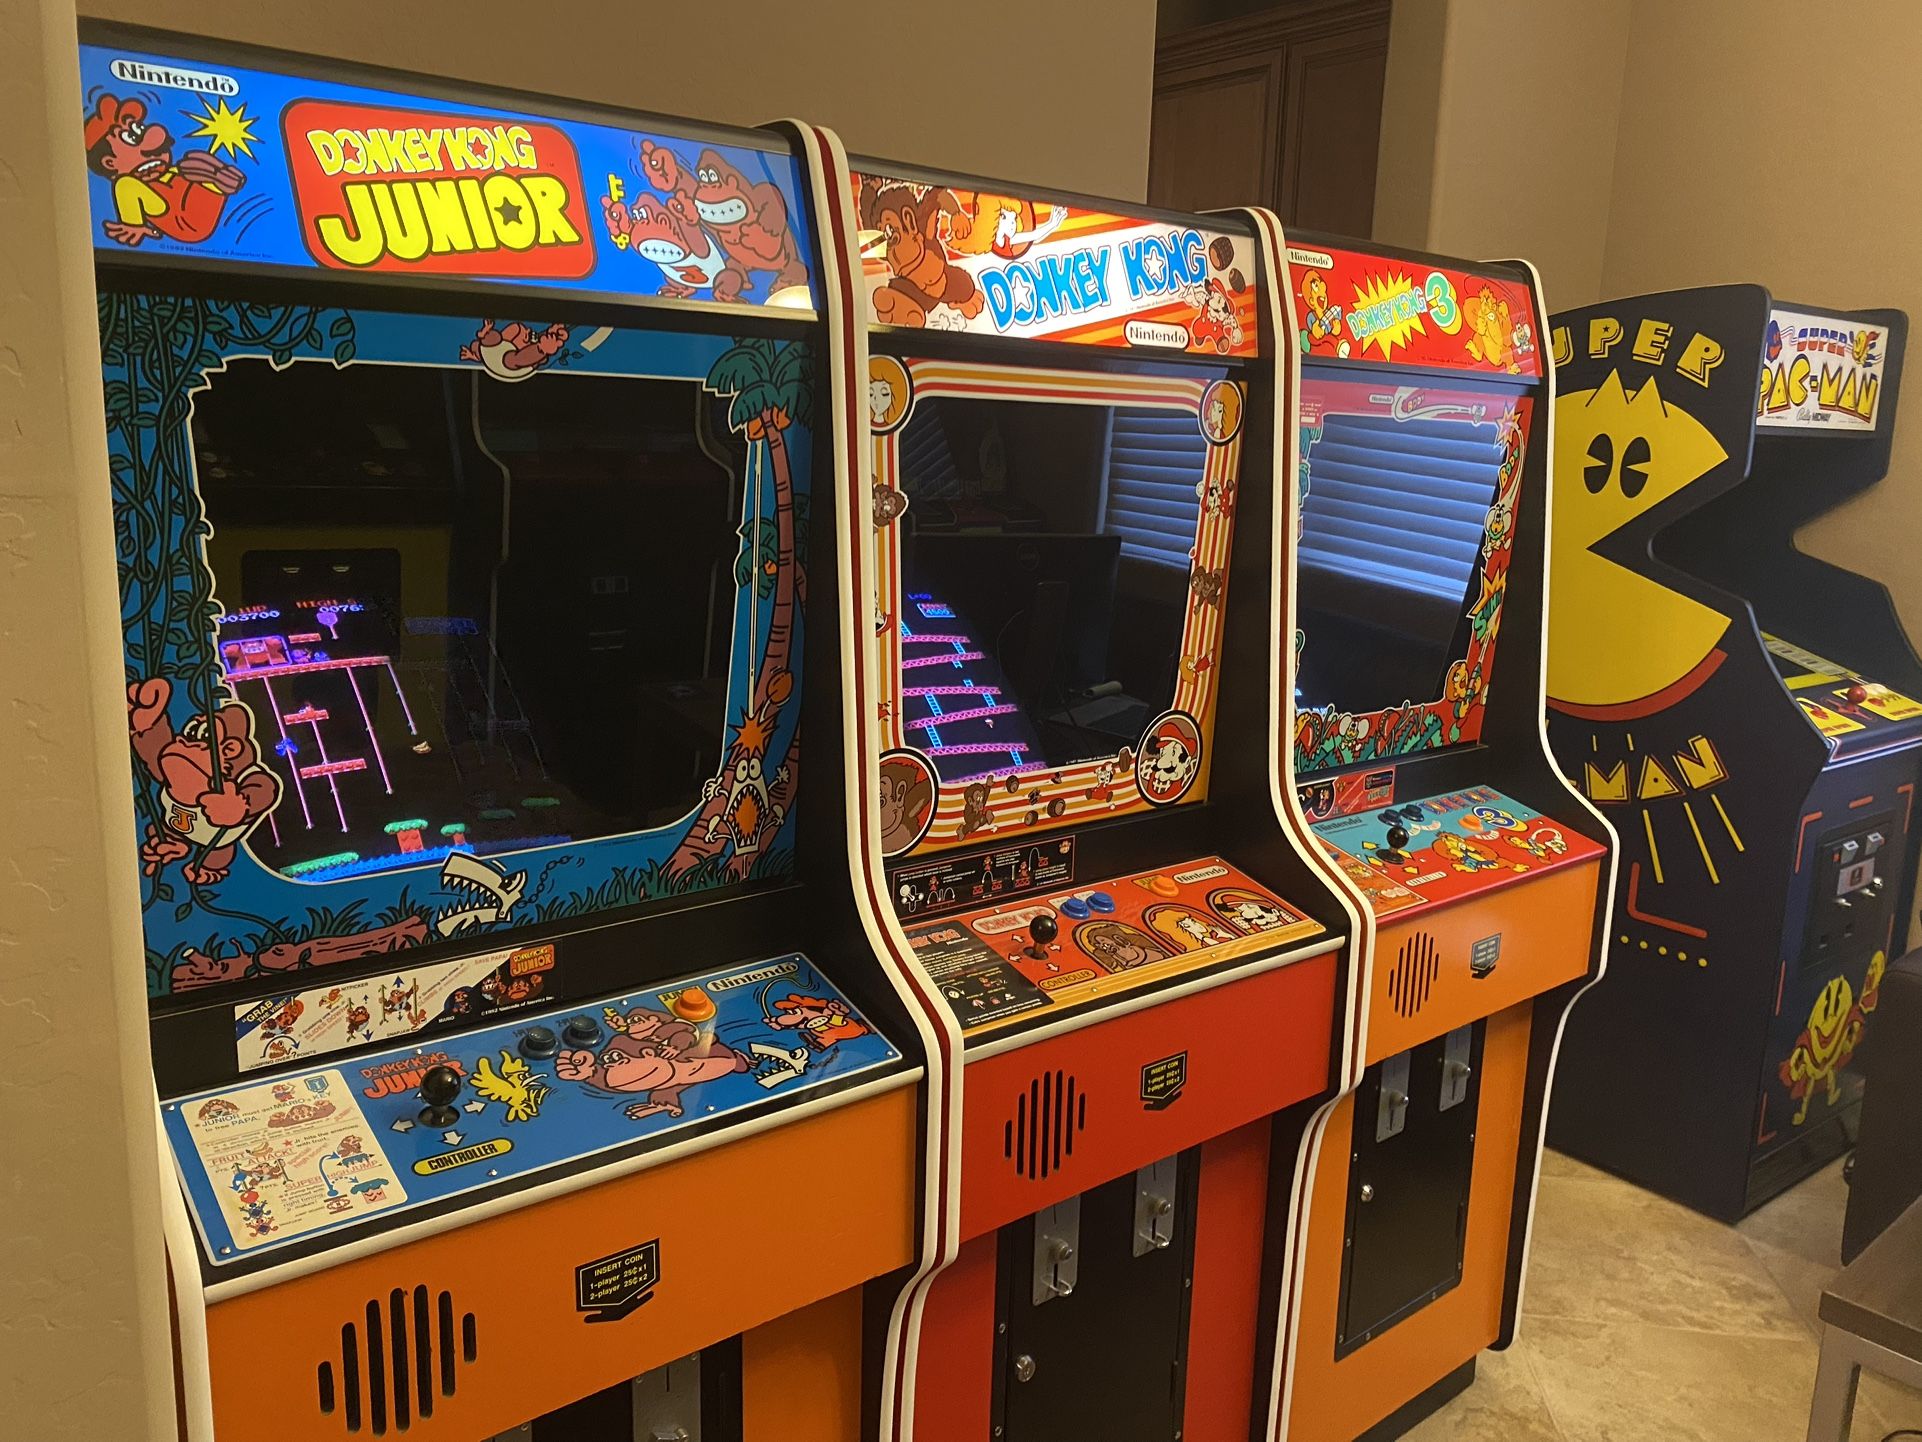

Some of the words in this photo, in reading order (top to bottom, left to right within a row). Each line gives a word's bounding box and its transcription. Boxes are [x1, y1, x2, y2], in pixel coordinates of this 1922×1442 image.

[117, 62, 234, 94] Nintendo
[307, 127, 444, 176] DONKEY
[443, 125, 538, 171] KONG
[315, 174, 583, 266] JUNIOR
[1290, 250, 1329, 266] Nintendo
[978, 245, 1111, 333] DONKEY
[1119, 228, 1209, 301] KONG
[1347, 301, 1394, 341] DONKEY
[1393, 286, 1427, 324] KONG
[1425, 272, 1459, 329] 3
[1129, 326, 1186, 344] Nintendo
[1796, 328, 1848, 357] SUPER
[1553, 317, 1725, 388] UPER
[1756, 353, 1879, 424] PAC-MAN
[1584, 735, 1730, 805] MAN
[1314, 816, 1362, 832] Nintendo
[1176, 867, 1226, 883] Nintendo
[512, 954, 552, 975] JUNIOR
[710, 962, 797, 990] Nintendo
[1041, 970, 1091, 988] CONTROLLER
[256, 1010, 271, 1023] THE
[438, 1015, 455, 1024] MARIO
[360, 1060, 414, 1079] DONKEY
[412, 1052, 449, 1070] KONG
[1167, 1060, 1179, 1069] COIN
[202, 1113, 240, 1128] JUNIOR
[312, 1091, 331, 1100] KEY
[211, 1152, 246, 1166] FRUIT
[427, 1143, 498, 1170] CONTROLLER
[285, 1175, 323, 1190] SUPER
[348, 1159, 379, 1175] JUMP
[594, 1260, 622, 1277] INSERT
[624, 1253, 644, 1266] COIN
[589, 1284, 620, 1300] 2-player
[590, 1275, 620, 1290] 1-player
